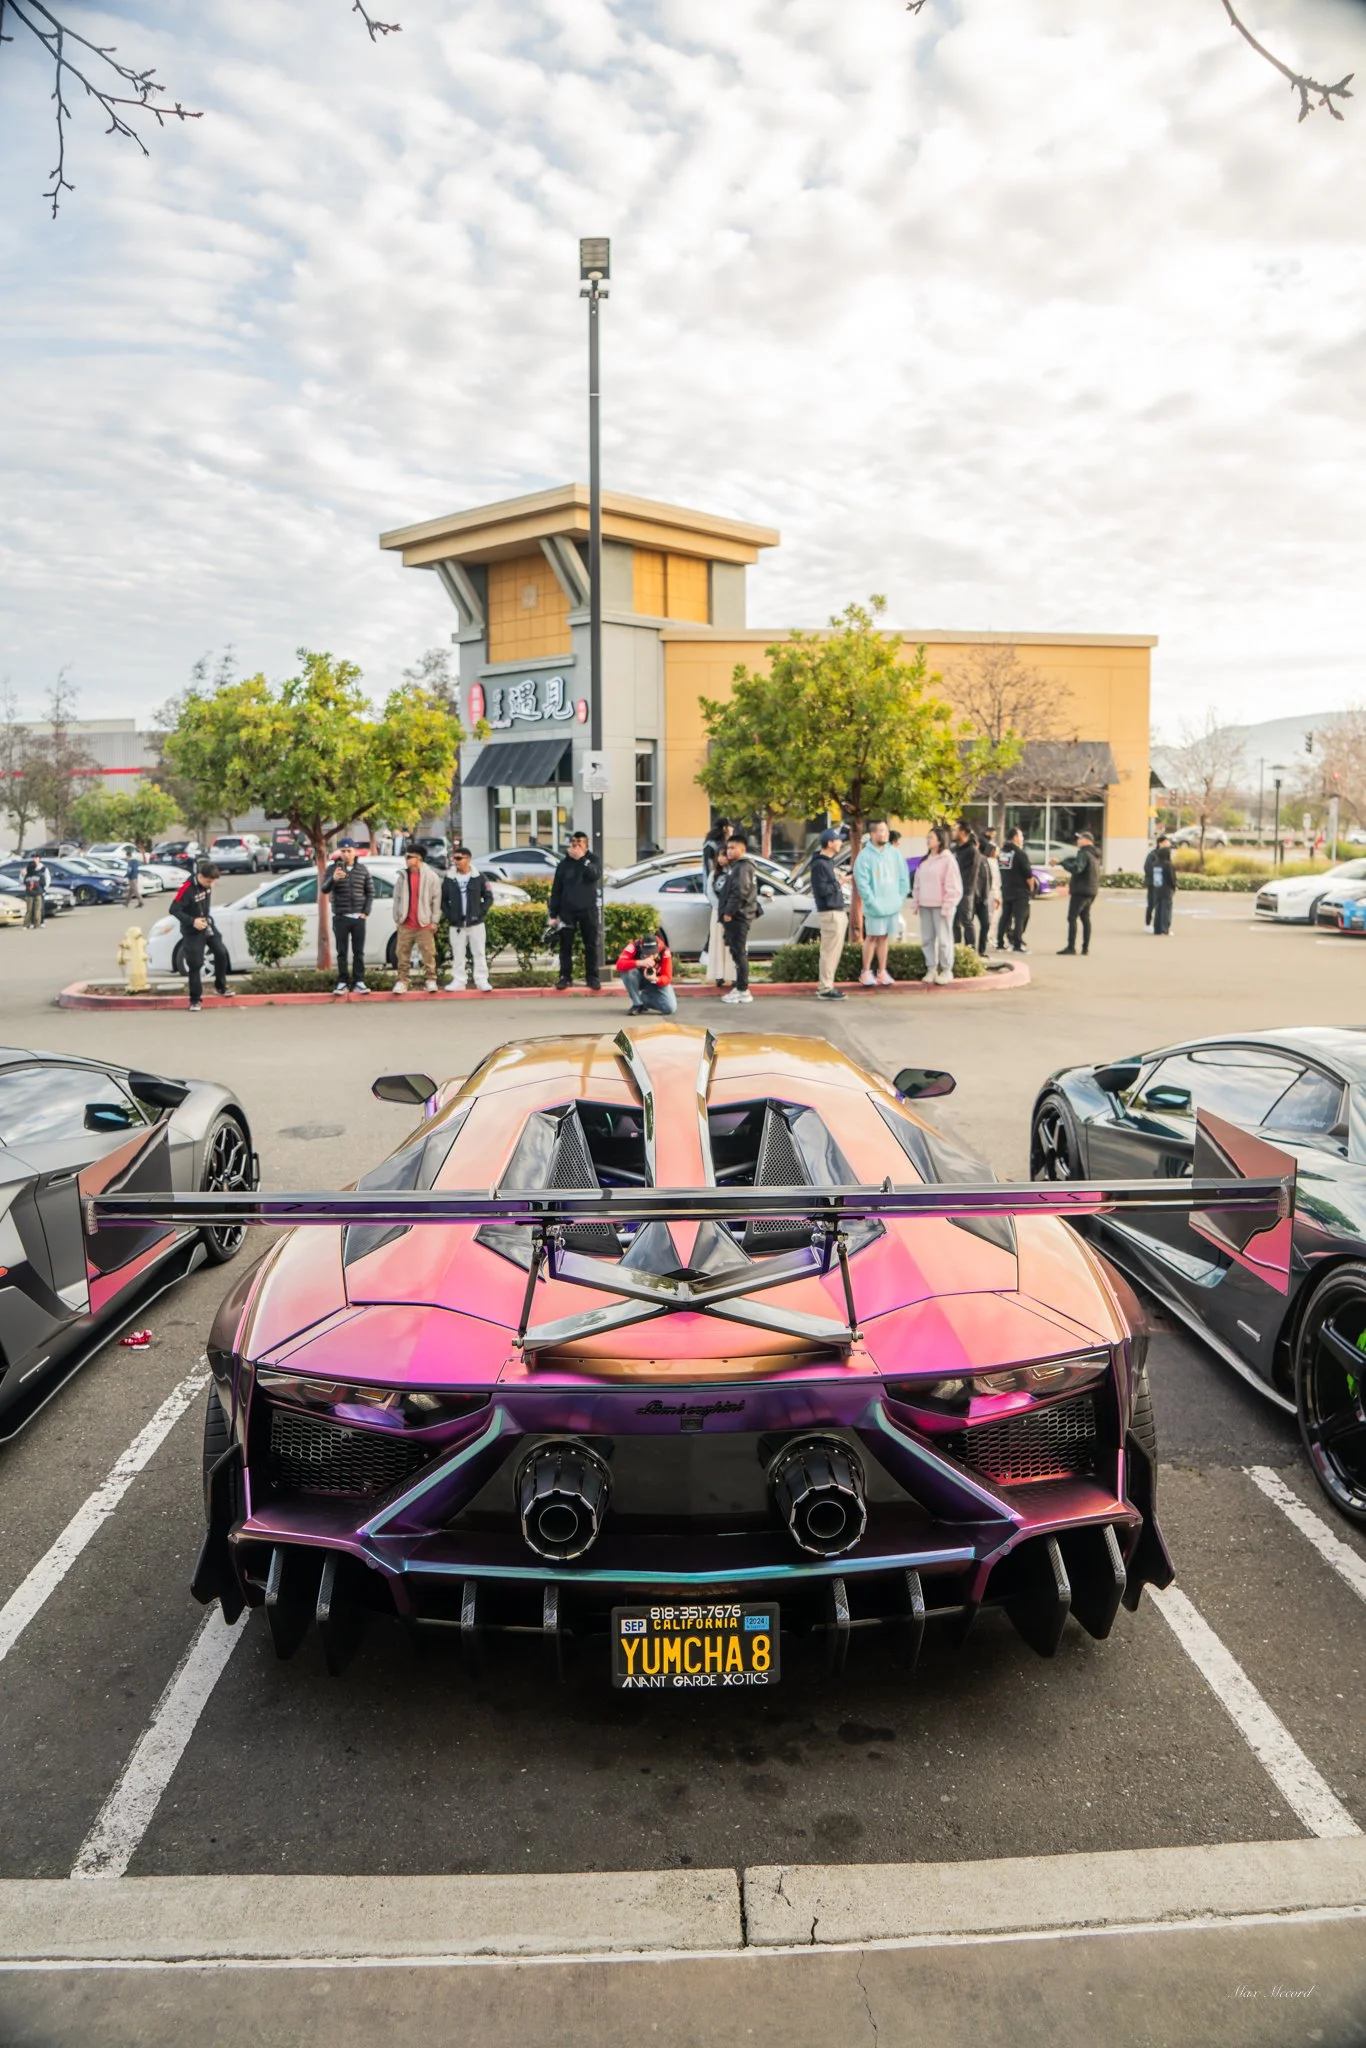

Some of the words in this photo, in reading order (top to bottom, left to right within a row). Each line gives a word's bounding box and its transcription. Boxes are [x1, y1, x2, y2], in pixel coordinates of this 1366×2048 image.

[635, 1400, 746, 1418] Lamborghini
[650, 1605, 741, 1619] 818-351-7676
[624, 1620, 644, 1631] SEP
[653, 1617, 738, 1630] CALIFORNIA
[749, 1617, 765, 1625] 2024
[621, 1635, 744, 1674] YUMCHA
[751, 1634, 771, 1672] 8
[621, 1675, 667, 1688] AVANT
[673, 1674, 717, 1687] GARDE
[722, 1672, 769, 1686] XOTICS
